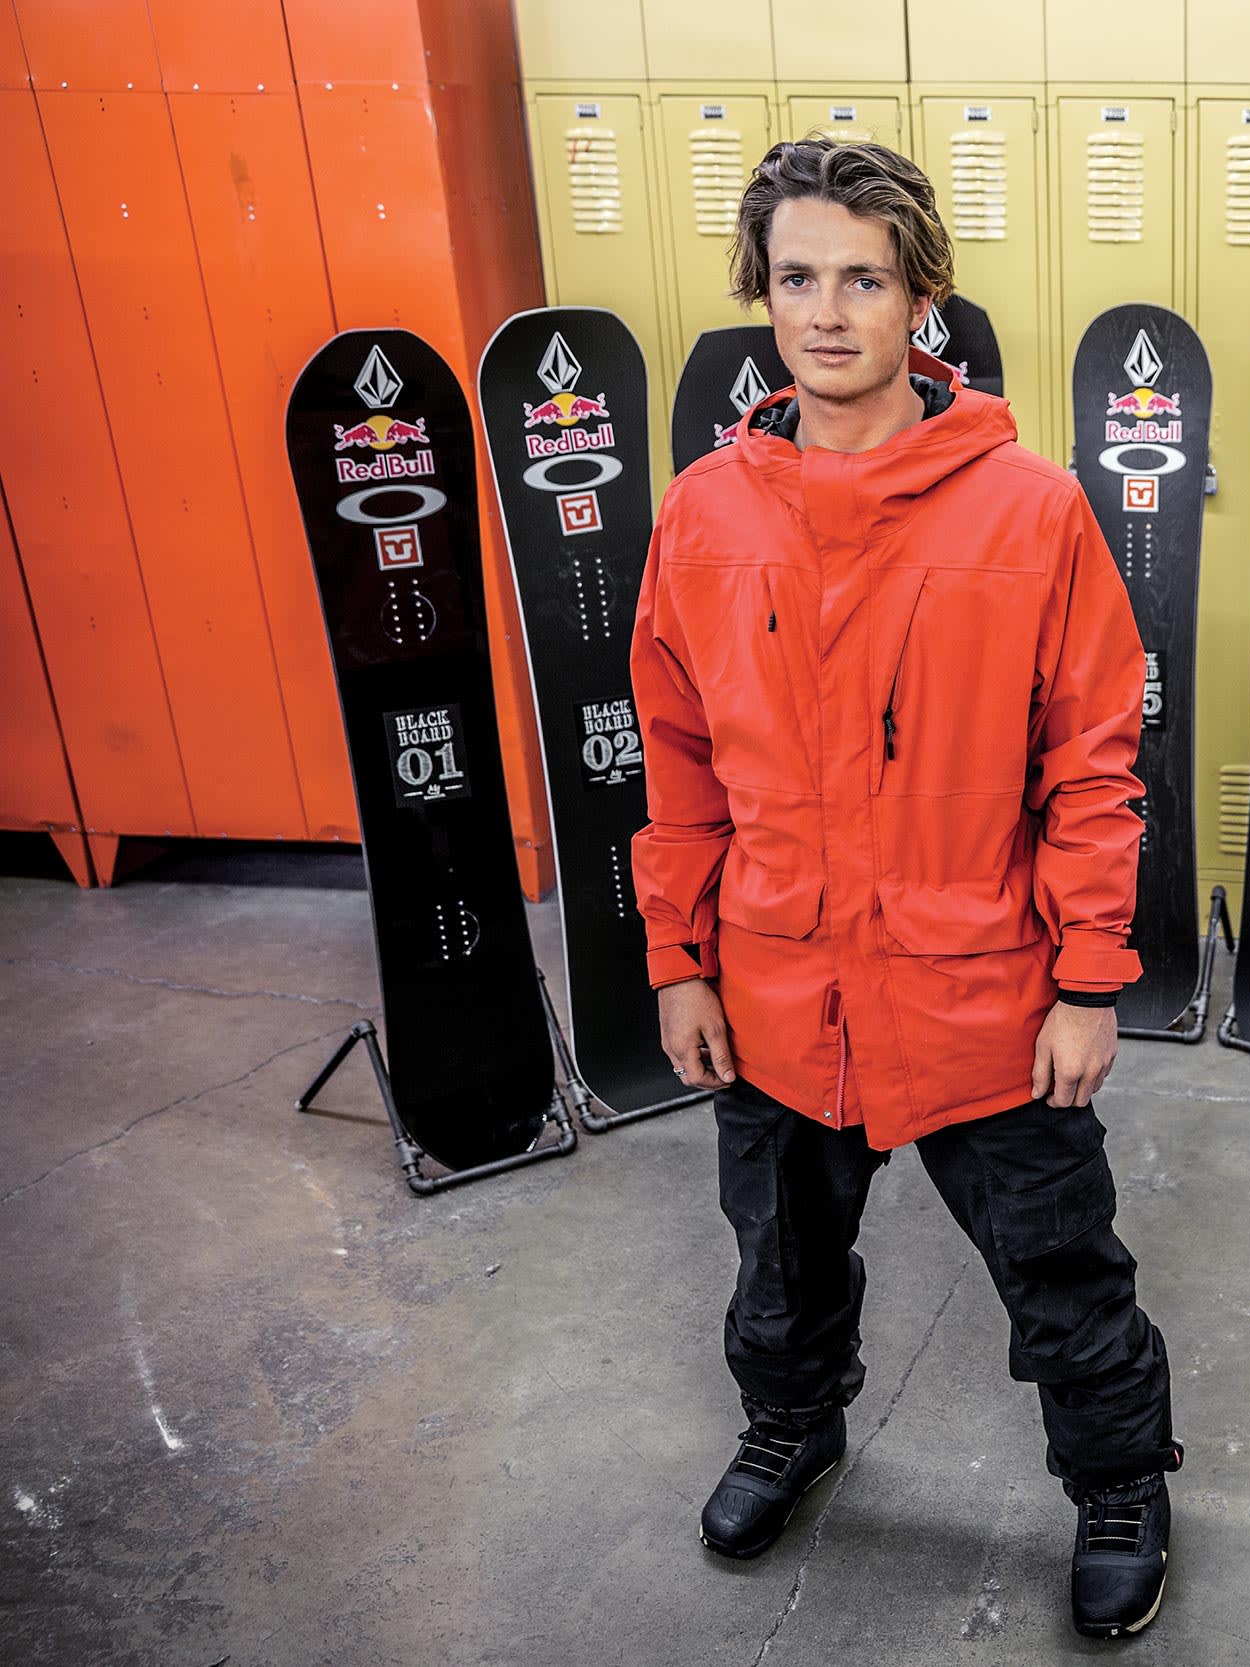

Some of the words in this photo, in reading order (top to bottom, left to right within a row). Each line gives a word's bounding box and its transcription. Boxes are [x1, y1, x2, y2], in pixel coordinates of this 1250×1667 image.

[582, 699, 631, 720] BLACK
[1143, 682, 1162, 716] 5
[395, 709, 450, 731] BLACK
[584, 714, 634, 735] BOARD
[398, 725, 453, 746] BOARD
[582, 730, 643, 771] 02
[396, 742, 464, 786] 01
